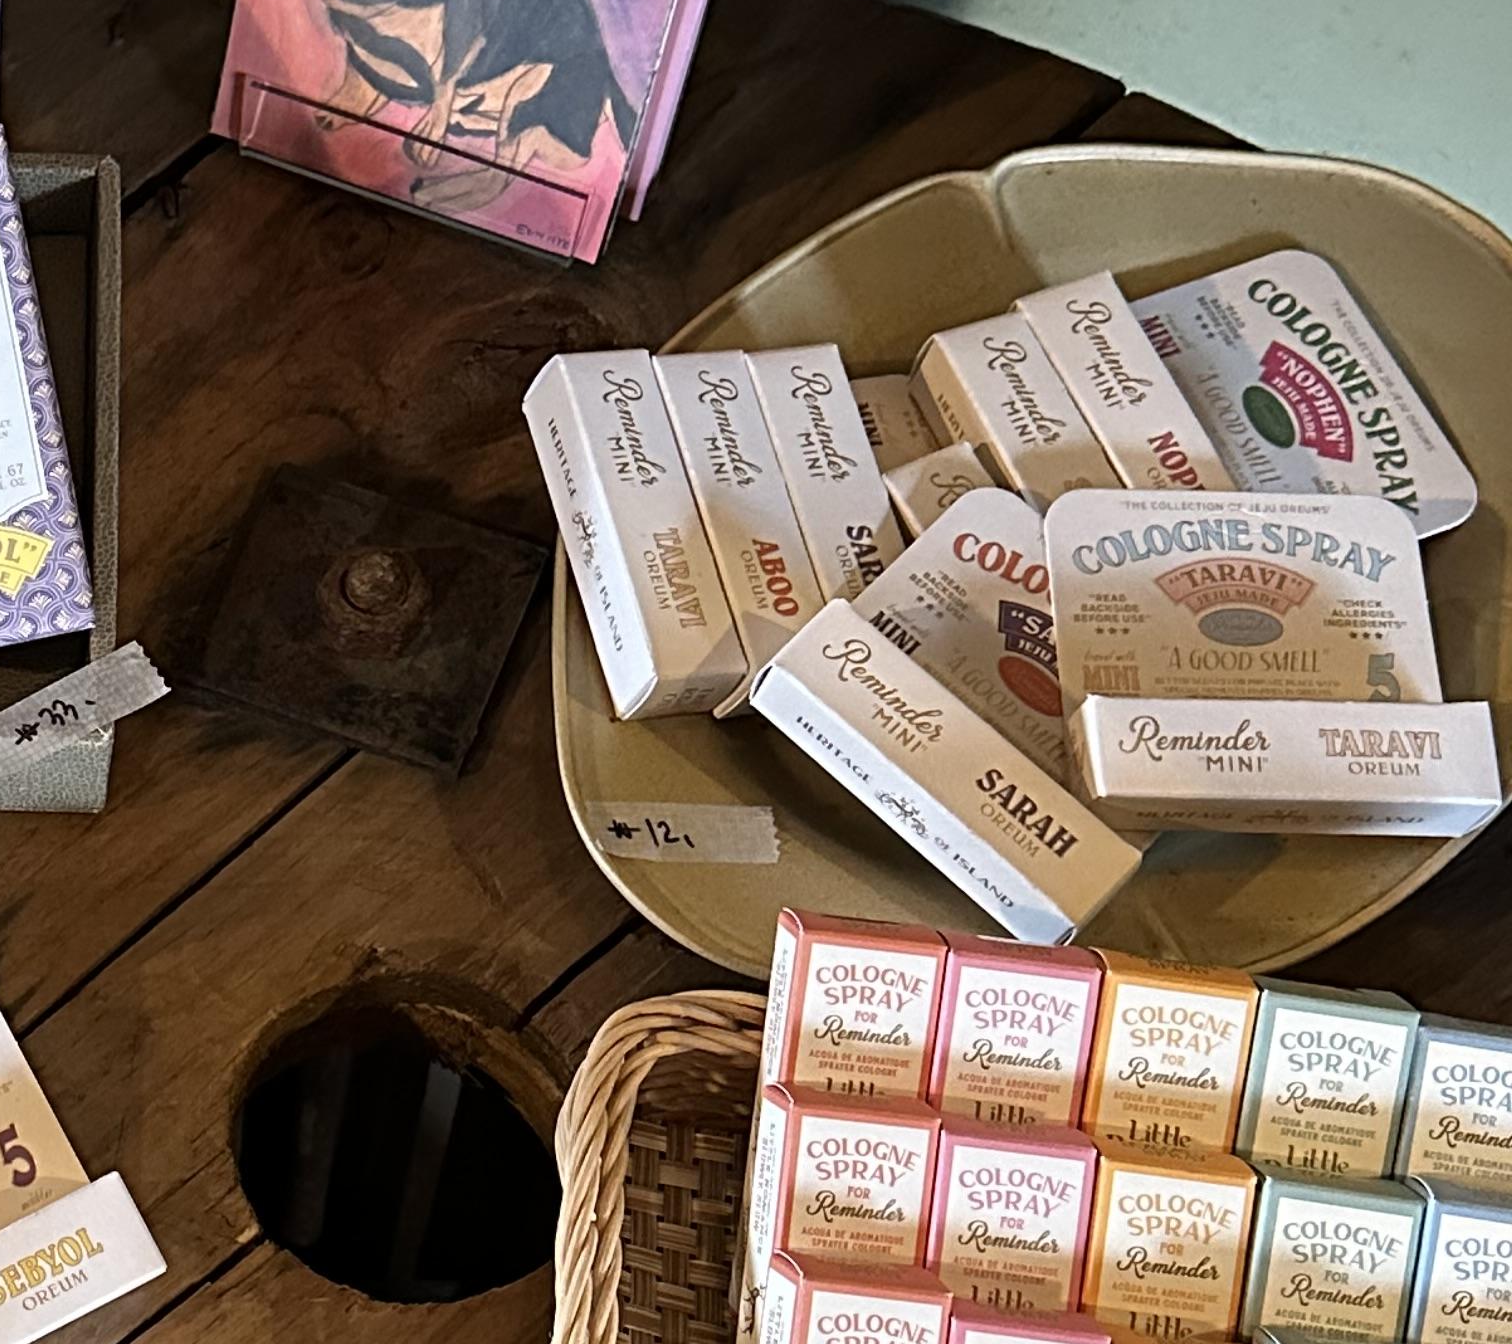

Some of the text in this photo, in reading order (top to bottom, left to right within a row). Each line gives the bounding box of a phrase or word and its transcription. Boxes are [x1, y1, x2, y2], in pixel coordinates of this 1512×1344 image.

[1066, 299, 1153, 410] Reminder
[984, 336, 1062, 446] Reminder
[1248, 278, 1420, 517] COLOGNE SPRAY
[603, 370, 666, 488] Reminder
[698, 370, 762, 489] Reminder
[791, 366, 857, 484] Reminder
[1072, 519, 1396, 583] COLOGNE SPRAY
[643, 550, 670, 611] OREUM
[653, 527, 706, 628] TARAVI
[740, 550, 767, 611] OREUM
[752, 539, 799, 617] ABOO
[823, 639, 945, 743] Reminder
[1119, 715, 1270, 761] Reminder
[1319, 728, 1442, 759] TARAVI
[1349, 762, 1420, 776] OREUM
[796, 715, 874, 783] HERITAGE
[952, 854, 1014, 907] ISLAND
[976, 768, 1079, 858] SARAH
[980, 802, 1040, 858] OREUM
[816, 964, 928, 997] COLOGNE
[965, 988, 1080, 1023] COLOGNE
[1122, 1006, 1238, 1041] COLOGNE
[815, 1015, 911, 1047] Reminder
[1280, 1031, 1397, 1067] COLOGNE
[963, 1039, 1063, 1072] Reminder
[1118, 1057, 1219, 1091] Reminder
[1277, 1082, 1378, 1117] Reminder
[806, 1138, 921, 1172] COLOGNE
[815, 1161, 906, 1188] SPRAY
[848, 1185, 870, 1199] FOR
[806, 1190, 905, 1224] Reminder
[967, 1191, 1060, 1218] SPRAY
[958, 1219, 1060, 1254] Reminder
[1127, 1216, 1220, 1245] SPRAY
[1283, 1221, 1402, 1258] COLOGNE
[1117, 1246, 1219, 1281] Reminder
[21, 1268, 88, 1311] OREUM
[1281, 1273, 1384, 1309] Reminder
